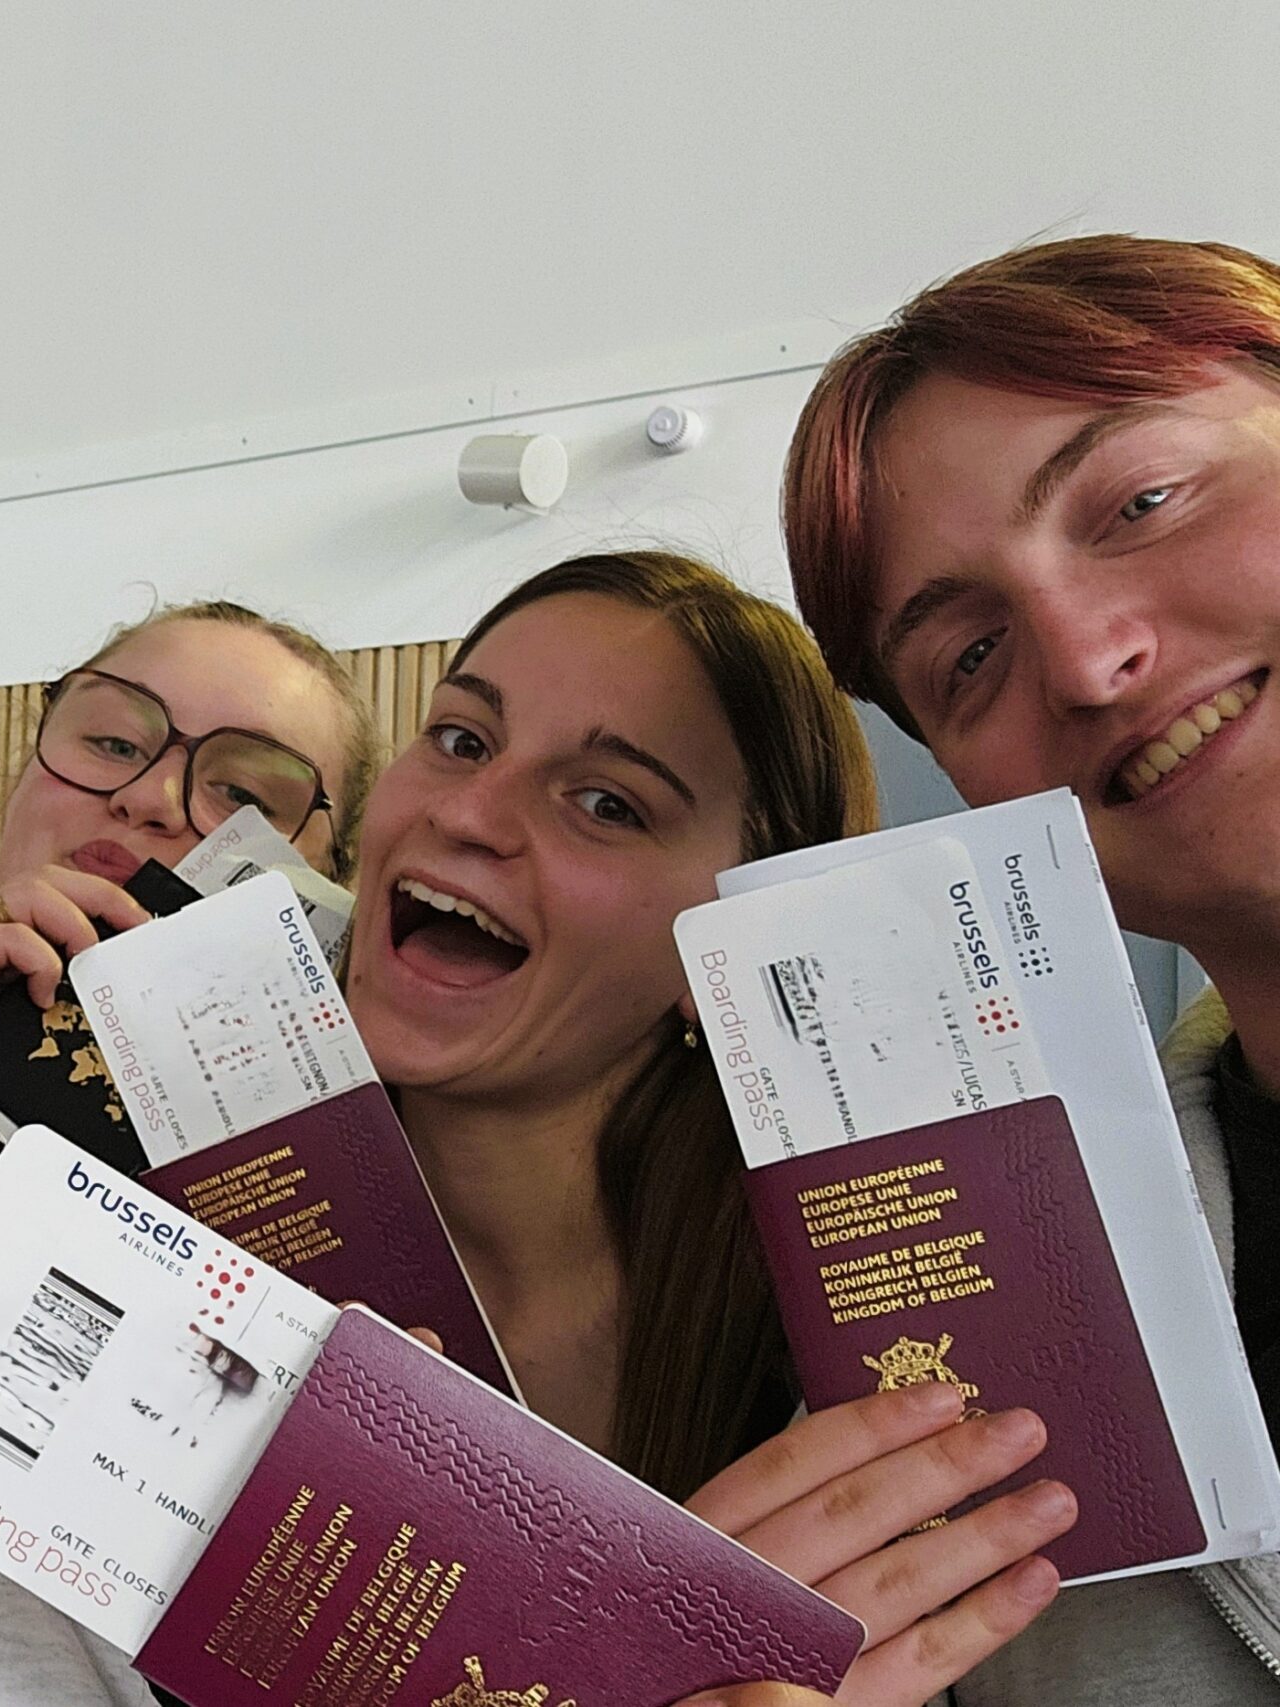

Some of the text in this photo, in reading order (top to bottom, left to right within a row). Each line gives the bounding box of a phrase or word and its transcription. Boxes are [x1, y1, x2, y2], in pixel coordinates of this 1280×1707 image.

[179, 828, 244, 883] Boarding
[1003, 853, 1043, 942] brussels
[947, 880, 1002, 990] brussels
[1003, 900, 1021, 945] AIRLINES
[277, 906, 329, 995] brussels
[951, 939, 976, 994] AIRLINES
[90, 984, 166, 1133] Boarding pass
[699, 948, 773, 1132] Boarding pass
[758, 1066, 797, 1160] GATE CLOSES
[950, 1088, 966, 1108] SN
[163, 1107, 188, 1150] CLOSES
[182, 1174, 221, 1197] UNION
[188, 1167, 271, 1209] EUROPESE UNIE
[257, 1186, 296, 1208] UNION
[267, 1167, 306, 1191] UNION
[797, 1158, 944, 1204] UNION EUROPÉENNE
[801, 1181, 912, 1219] EUROPESE UNIE
[63, 1160, 203, 1262] brussels
[261, 1220, 277, 1235] DE
[277, 1199, 332, 1229] BELGIQUE
[805, 1187, 958, 1234] EUROPÄISCHE UNION
[809, 1207, 942, 1248] EUROPEAN UNION
[117, 1231, 185, 1278] AIRLINES
[276, 1255, 292, 1270] OF
[293, 1236, 343, 1264] BELGIUM
[285, 1227, 332, 1253] BELGIEN
[819, 1230, 985, 1279] ROYAUME DE BELGIQUE
[823, 1250, 964, 1294] KONINKRIJK BELGIË
[828, 1263, 981, 1309] KÖNIGREICH BELGIEN
[832, 1276, 994, 1324] KINGDOM OF BELGIUM
[274, 1309, 318, 1342] A STAR
[91, 1452, 128, 1482] MAX
[134, 1478, 148, 1495] 1
[308, 1502, 354, 1565] UNION
[33, 1542, 120, 1608] pass
[48, 1523, 169, 1606] GATE CLOSES
[202, 1482, 317, 1656] UNION EUROPÉENNE
[272, 1538, 309, 1583] UNIE
[312, 1537, 358, 1600] UNION
[343, 1605, 369, 1633] DE
[358, 1521, 419, 1608] BELGIQUE
[373, 1560, 419, 1624] BELGIË
[392, 1558, 445, 1633] BELGIEN
[397, 1560, 468, 1666] OF BELGIUM
